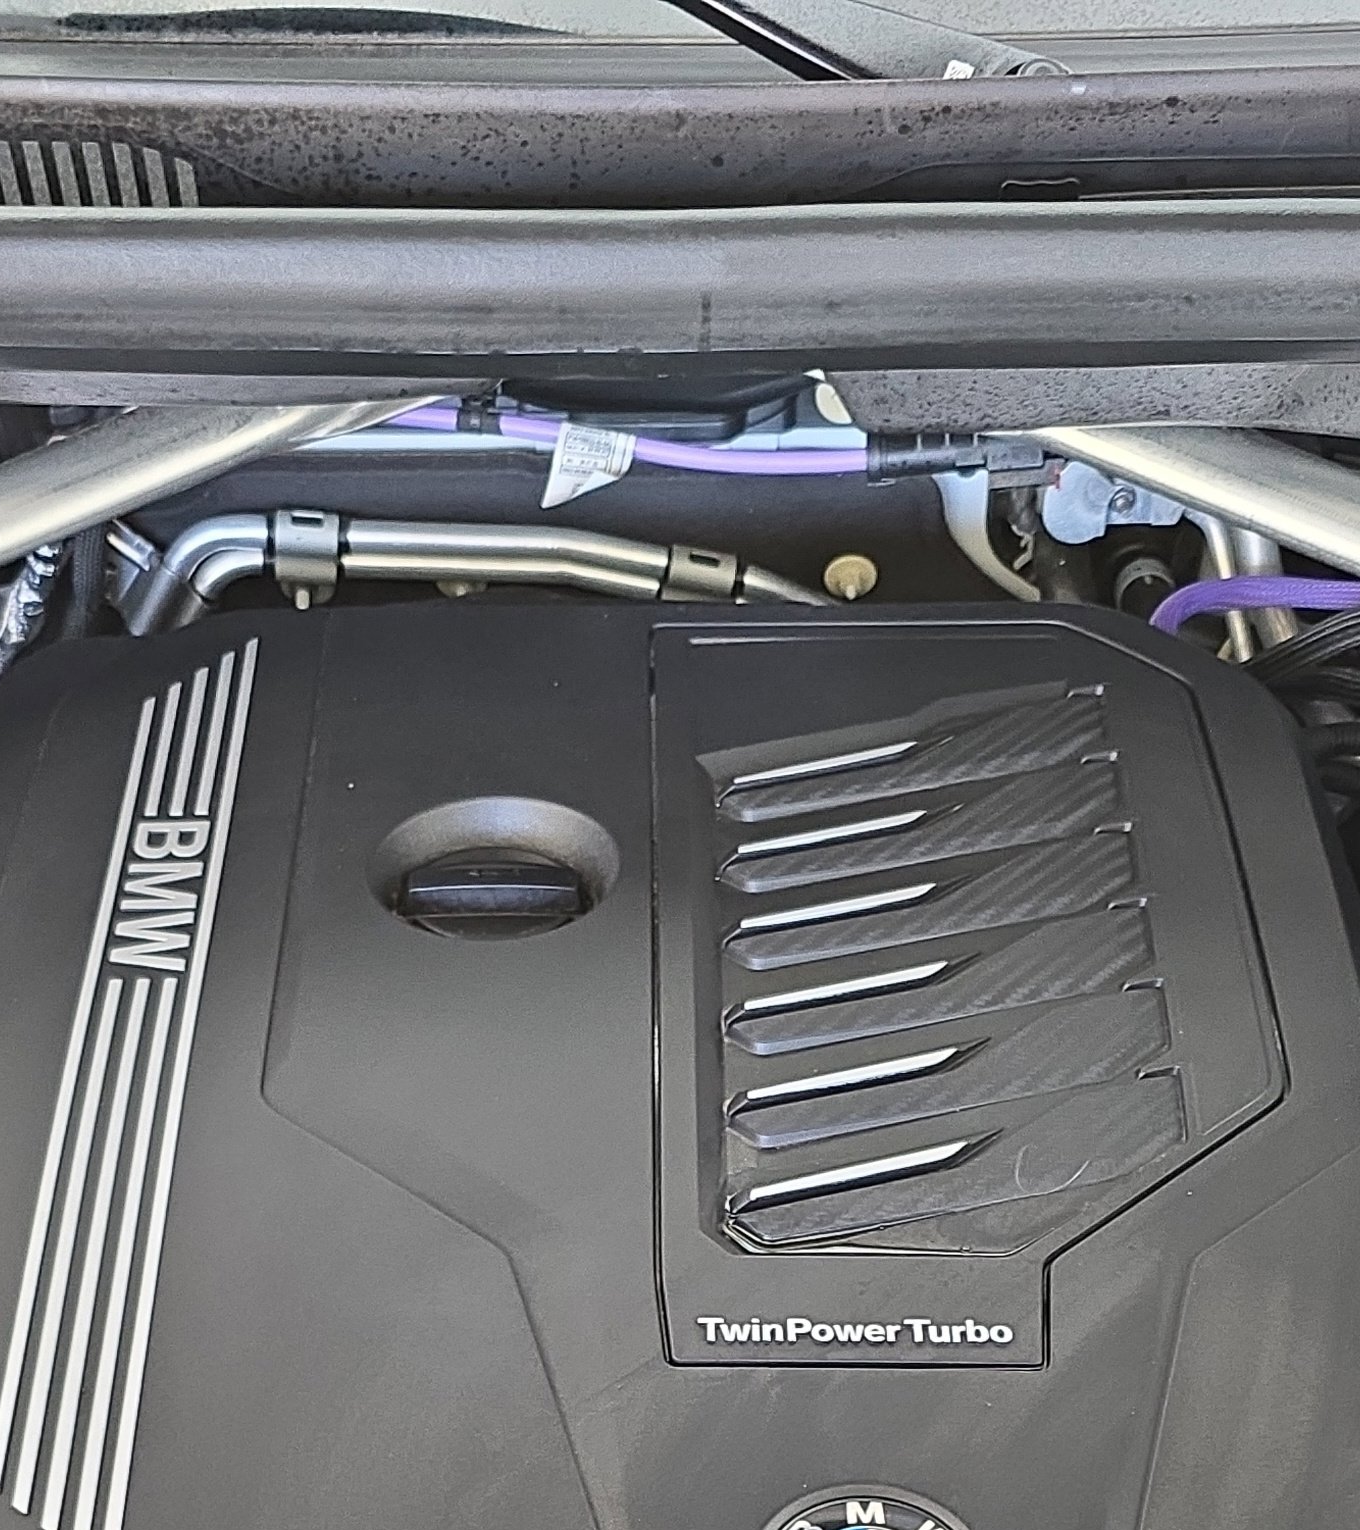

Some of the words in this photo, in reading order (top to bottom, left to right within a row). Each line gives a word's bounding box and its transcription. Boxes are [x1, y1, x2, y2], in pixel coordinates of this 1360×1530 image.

[108, 820, 211, 972] BMW
[696, 1316, 901, 1343] TwinPower
[902, 1317, 1015, 1344] Turbo
